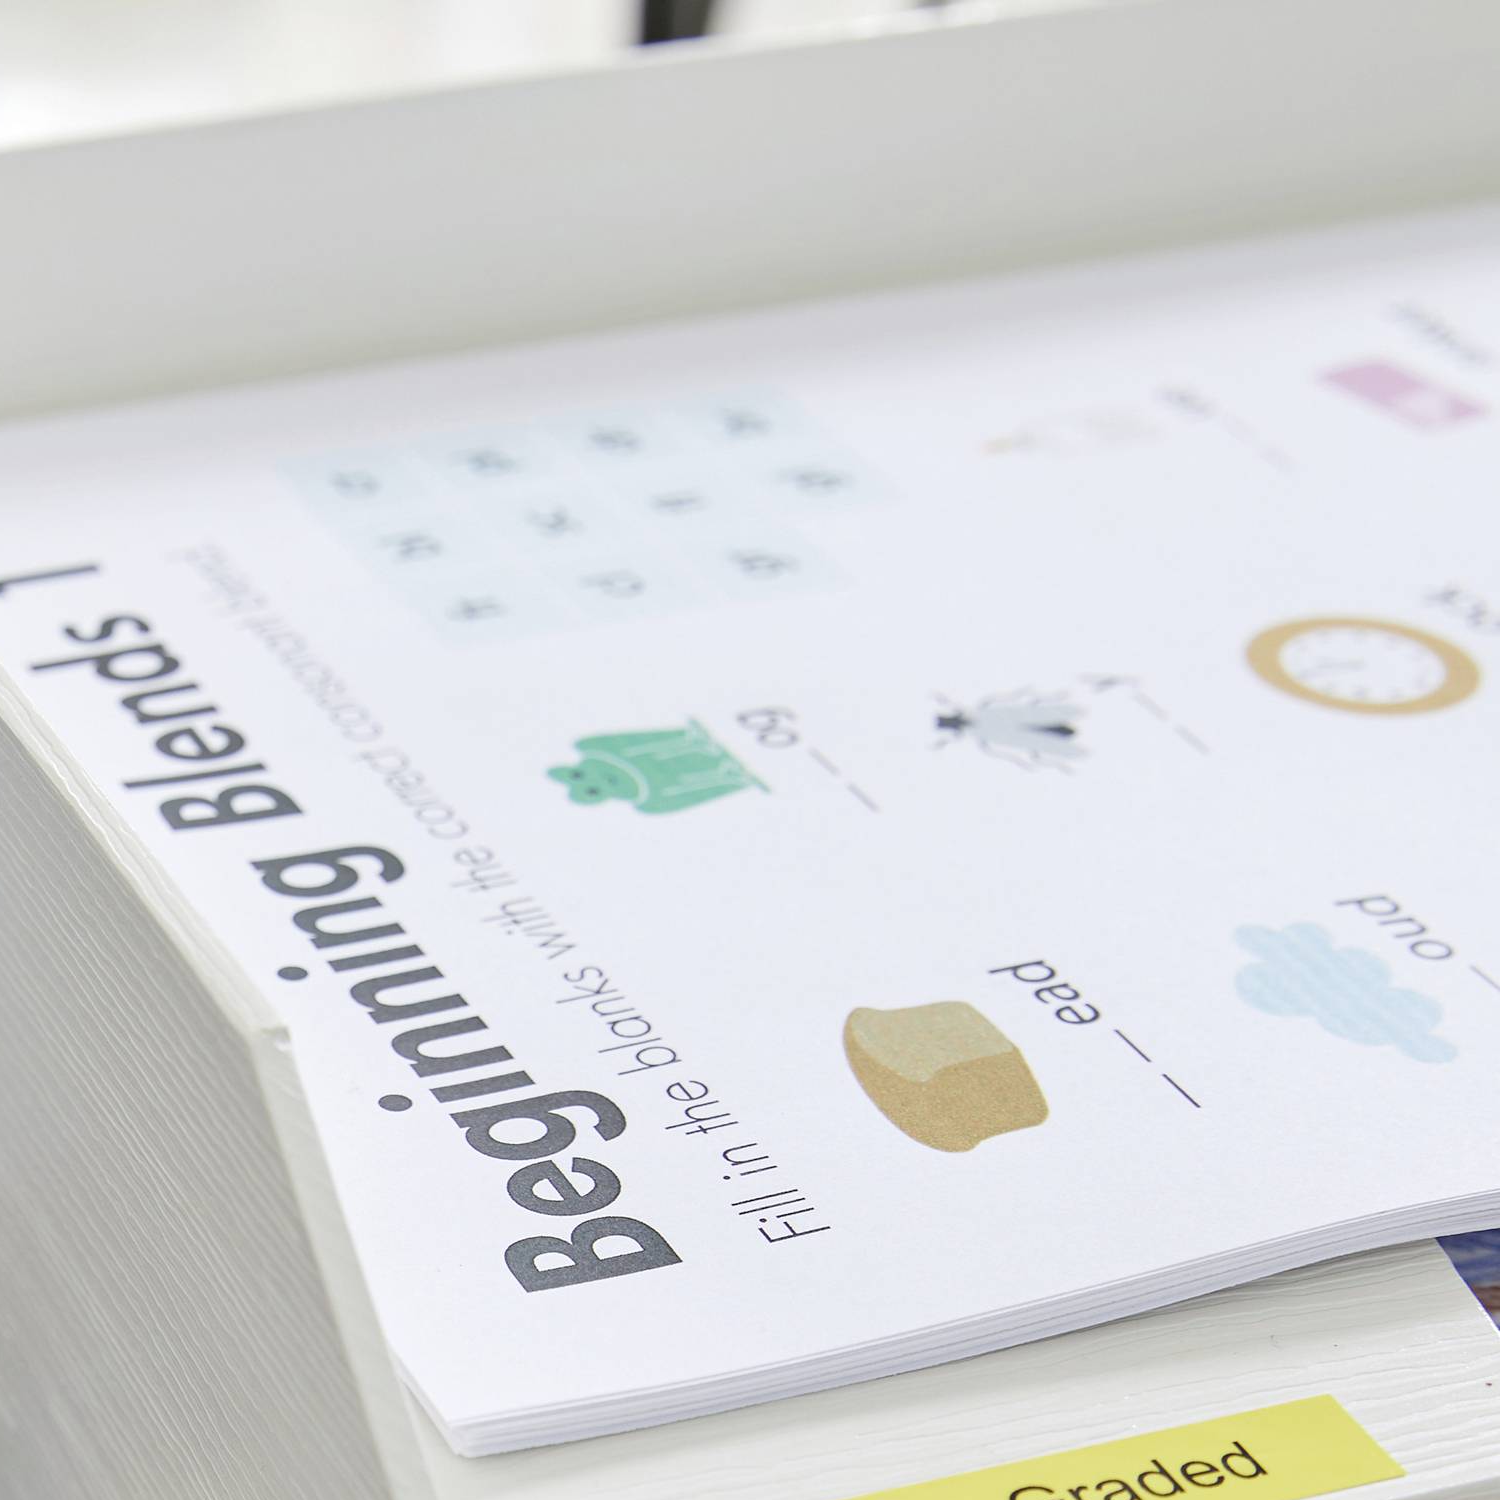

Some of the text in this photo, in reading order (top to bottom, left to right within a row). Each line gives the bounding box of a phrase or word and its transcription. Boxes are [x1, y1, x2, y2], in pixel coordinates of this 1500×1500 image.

[30, 616, 304, 831] Blends
[450, 846, 517, 893] the
[482, 896, 577, 960] with
[556, 965, 683, 1076] blanks
[987, 958, 1101, 1027] ead
[250, 846, 682, 1292] Beginning
[665, 1080, 739, 1135] the
[723, 1143, 777, 1180] in
[731, 1188, 831, 1243] Fill
